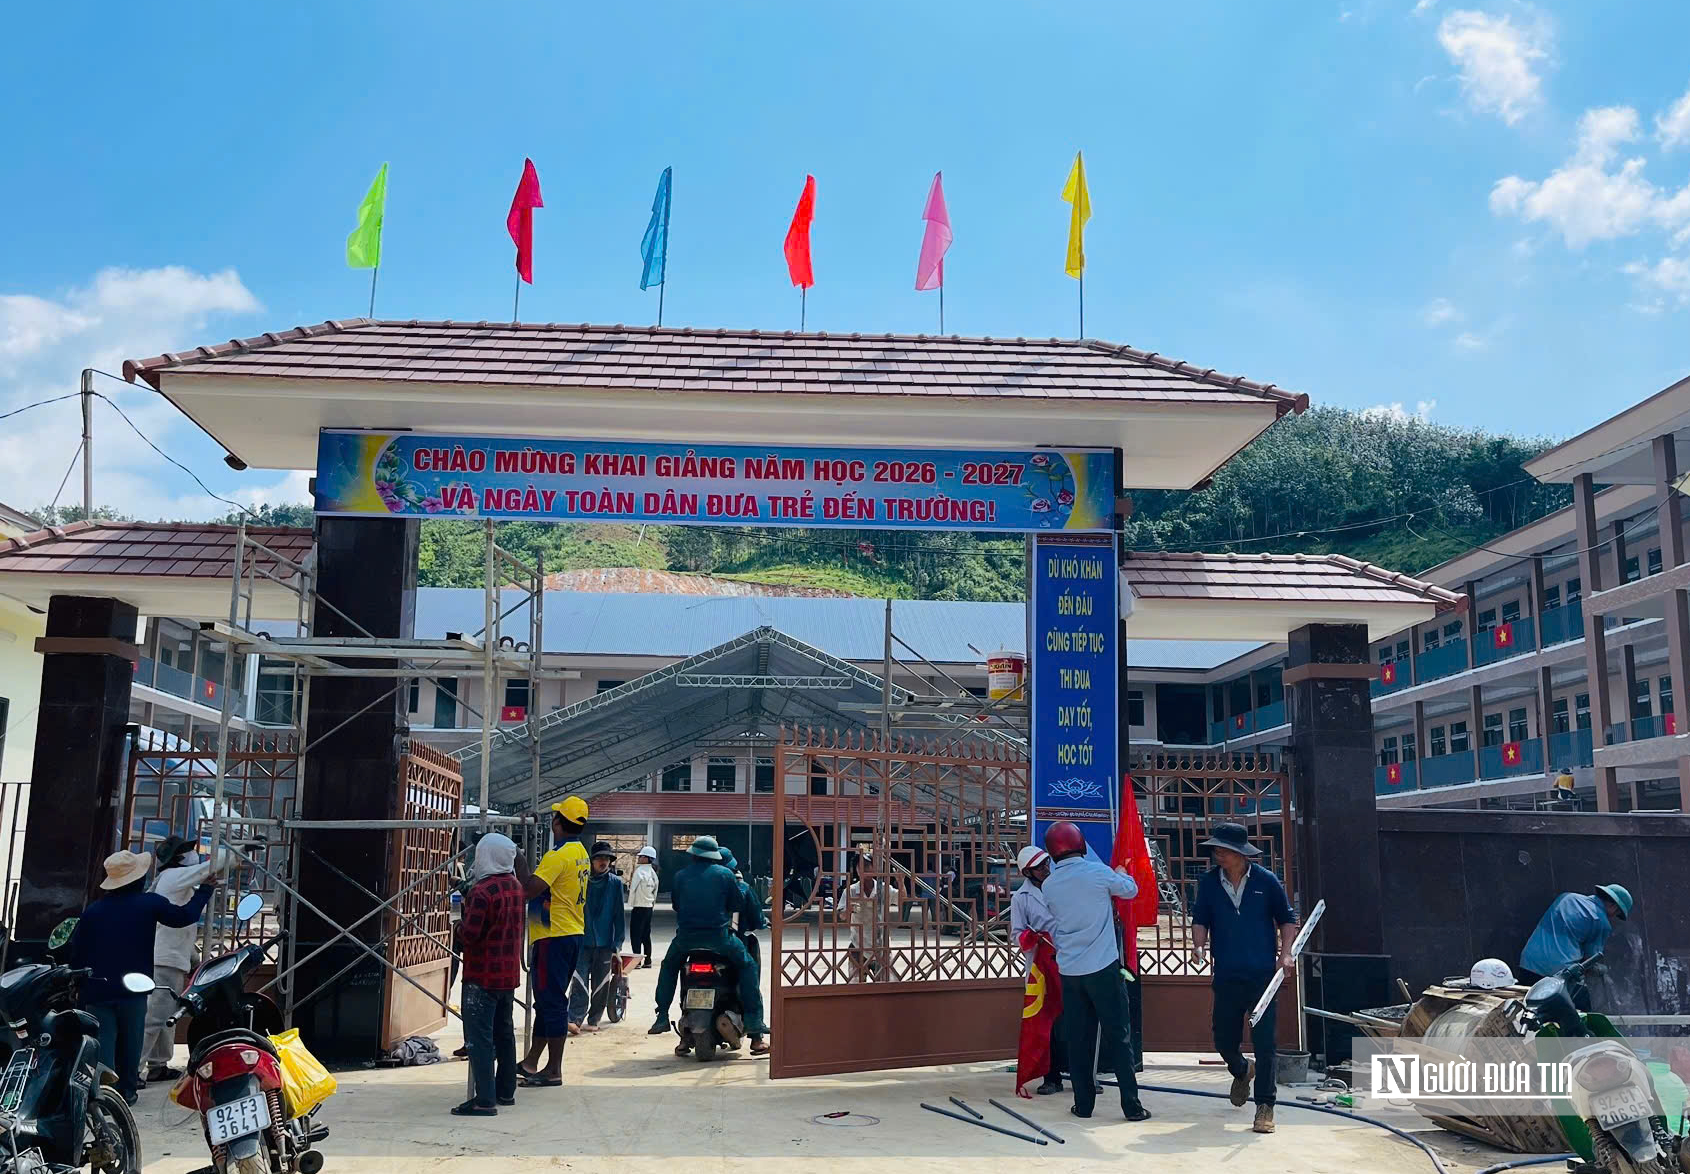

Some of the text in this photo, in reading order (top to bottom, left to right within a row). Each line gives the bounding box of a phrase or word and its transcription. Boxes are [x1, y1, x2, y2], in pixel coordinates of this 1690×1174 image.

[413, 444, 486, 472] CHÀO
[495, 447, 576, 475] MỪNG
[584, 453, 646, 477] KHAI
[655, 450, 736, 479] GIẢNG
[744, 454, 805, 481] NĂM
[814, 460, 865, 486] HỌC
[873, 461, 936, 484] 2026
[962, 463, 1025, 485] 2027
[441, 483, 995, 522] VÀ NGÀY TOÀN DÂN ĐƯA TRẺ ĐẾN TRƯỜNG!
[1048, 553, 1103, 579] DÙ KHÓ KHĂN
[1058, 587, 1093, 616] ĐẾN ĐÂU
[1046, 624, 1104, 659] CŨNG TIẾP TỤC
[1060, 668, 1091, 690] THI ĐUA
[1058, 698, 1093, 733] DẠY TỐT,
[1058, 736, 1094, 771] HỌC TỐT
[216, 1098, 258, 1123] 92-F3
[218, 1113, 259, 1139] 3641
